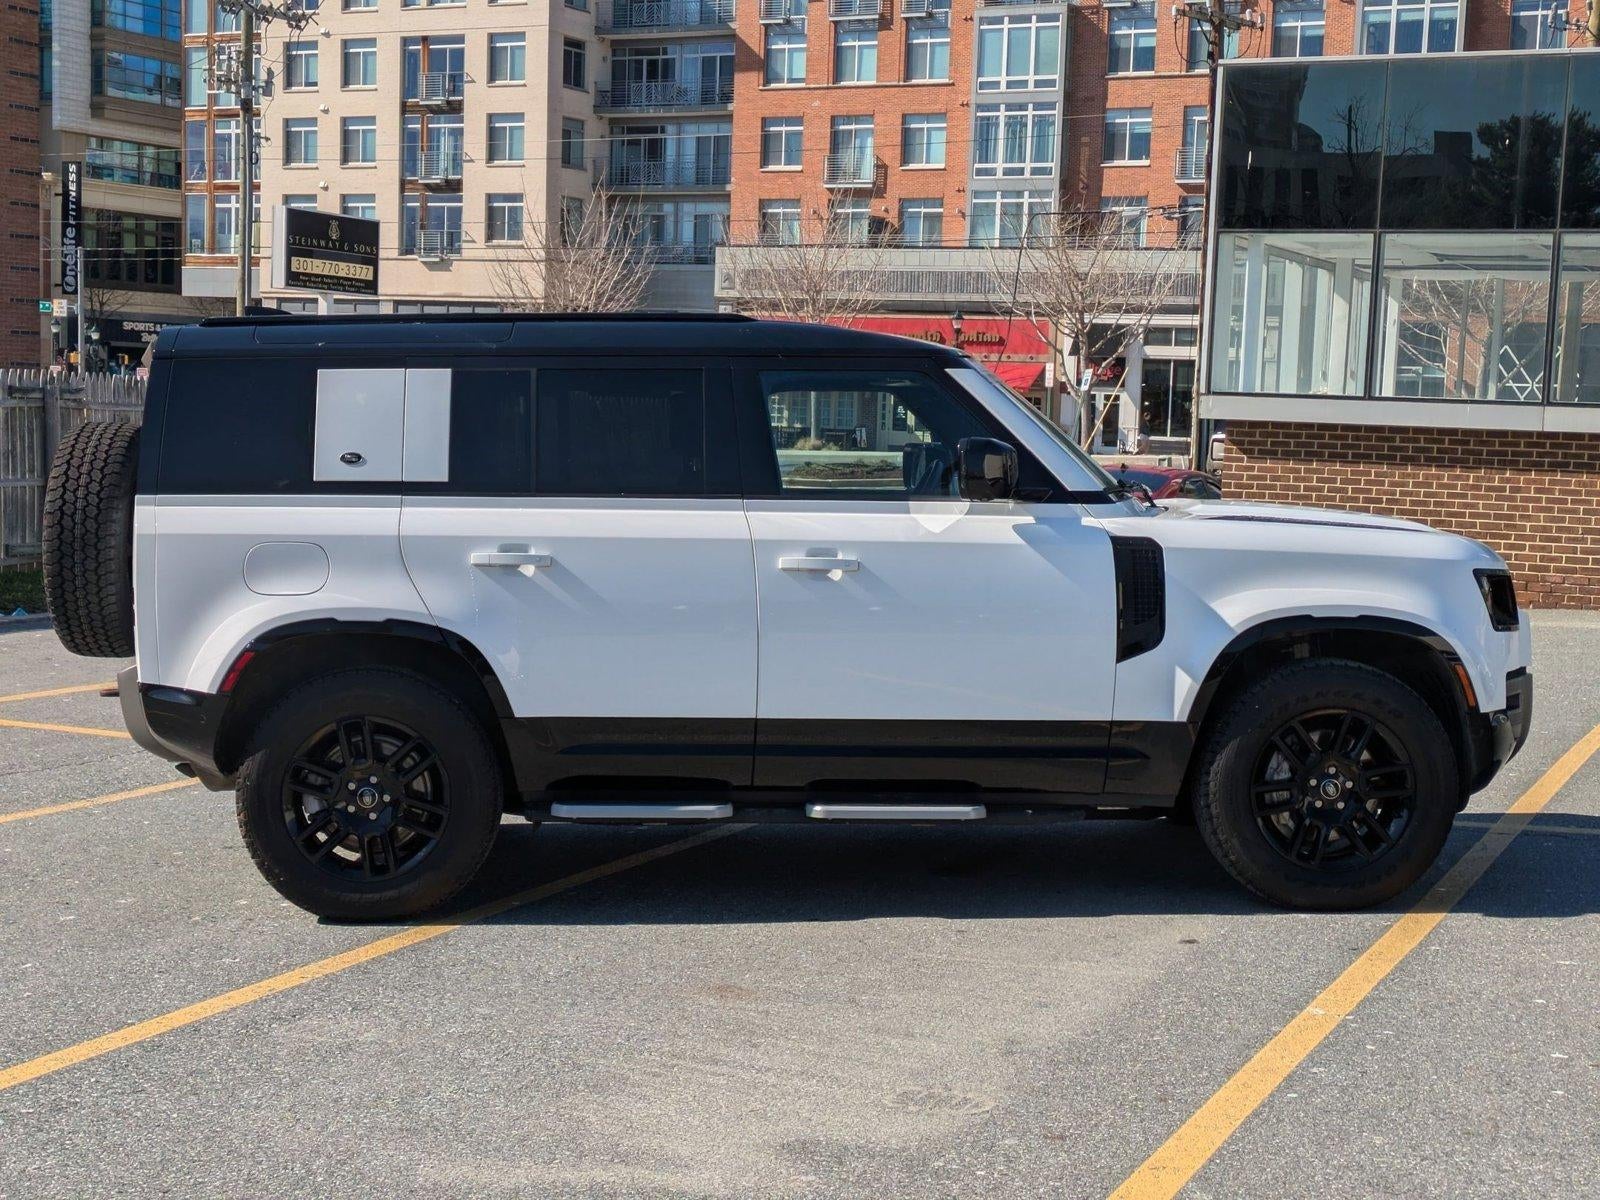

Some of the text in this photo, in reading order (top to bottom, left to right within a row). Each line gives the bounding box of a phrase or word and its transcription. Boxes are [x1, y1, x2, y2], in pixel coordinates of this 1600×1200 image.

[68, 163, 77, 225] FITNESS
[288, 235, 339, 249] STEINWAY
[354, 244, 377, 254] SONS
[295, 259, 370, 278] 301-770-3377
[122, 321, 155, 332] SPORTS
